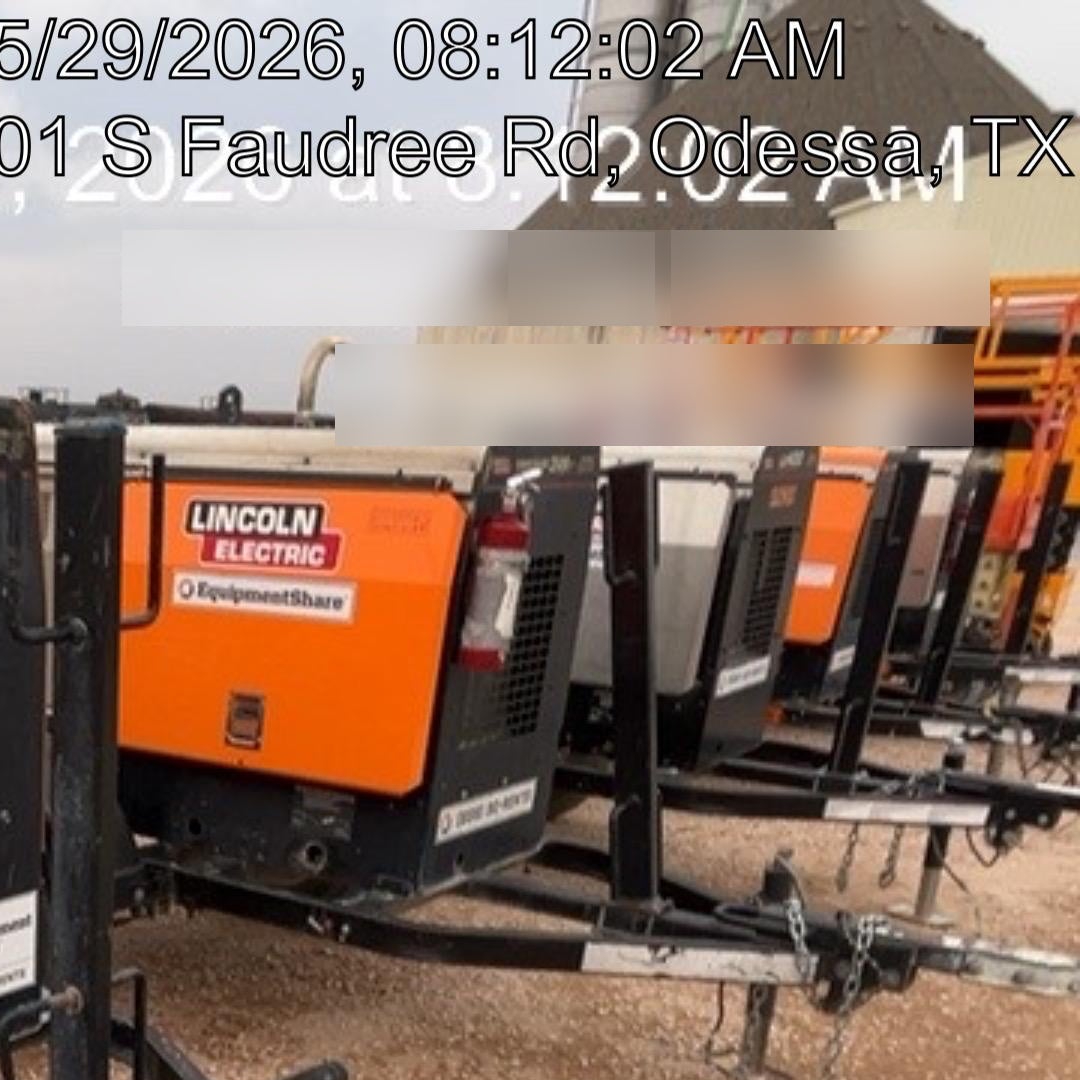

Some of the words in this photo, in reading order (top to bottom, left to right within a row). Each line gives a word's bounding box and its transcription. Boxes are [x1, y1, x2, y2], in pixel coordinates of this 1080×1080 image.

[190, 502, 318, 538] LINCOLN
[214, 538, 327, 567] ELECTRIC
[196, 580, 345, 611] EquipmentShare
